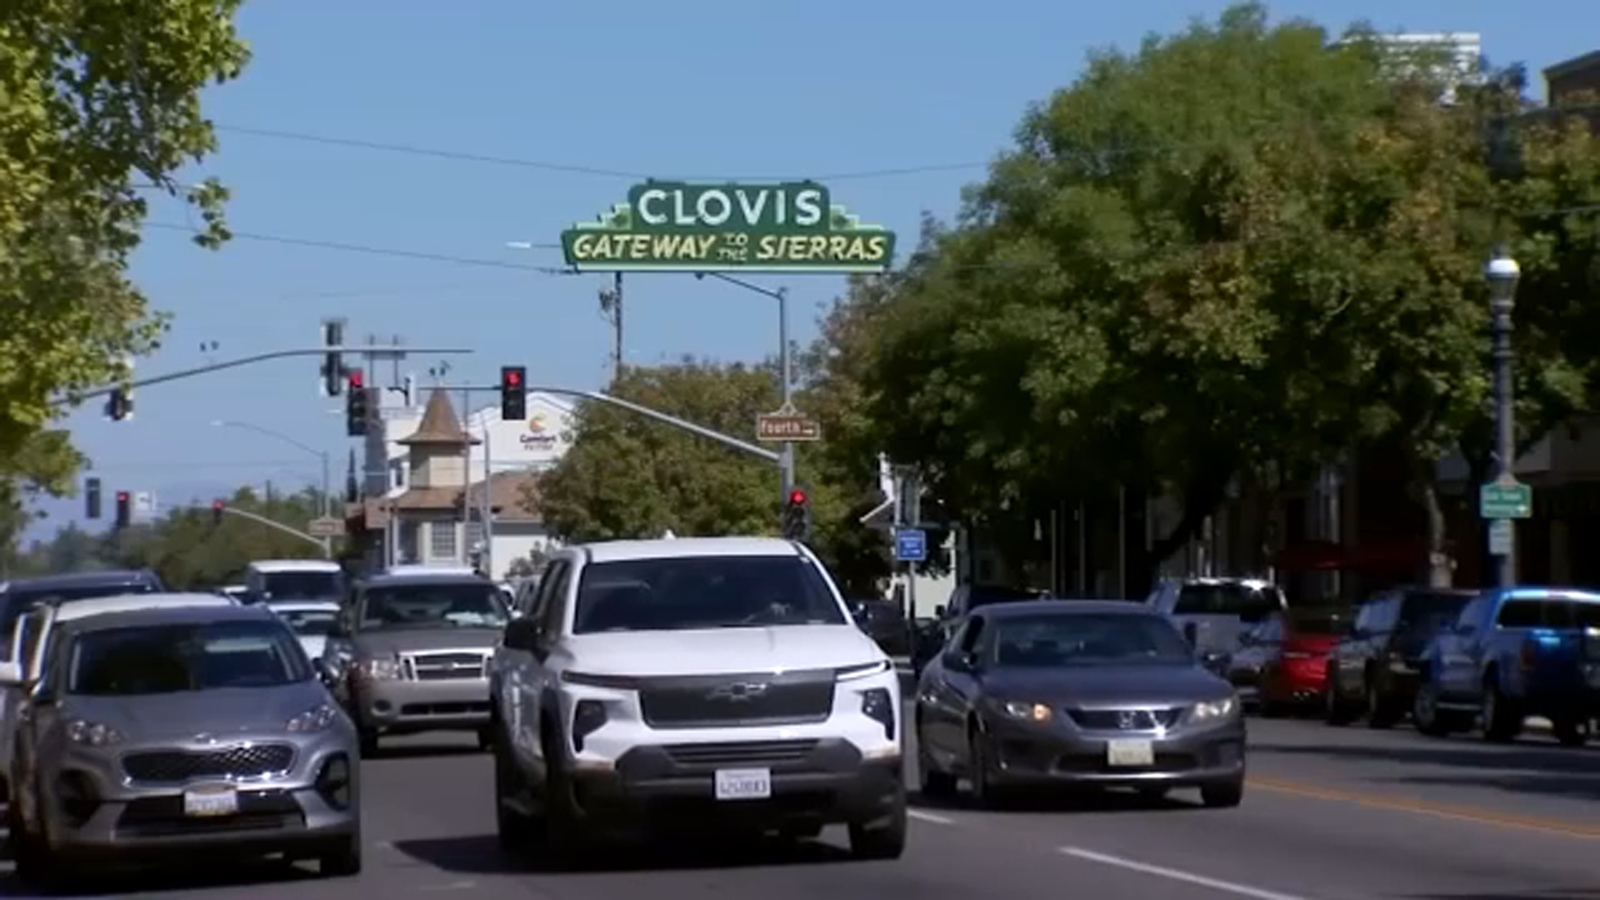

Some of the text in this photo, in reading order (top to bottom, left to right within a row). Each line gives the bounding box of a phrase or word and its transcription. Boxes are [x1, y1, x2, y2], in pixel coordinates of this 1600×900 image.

[638, 189, 822, 226] CLOVIS
[572, 233, 885, 261] GATEWAY TO THE SIERRAS
